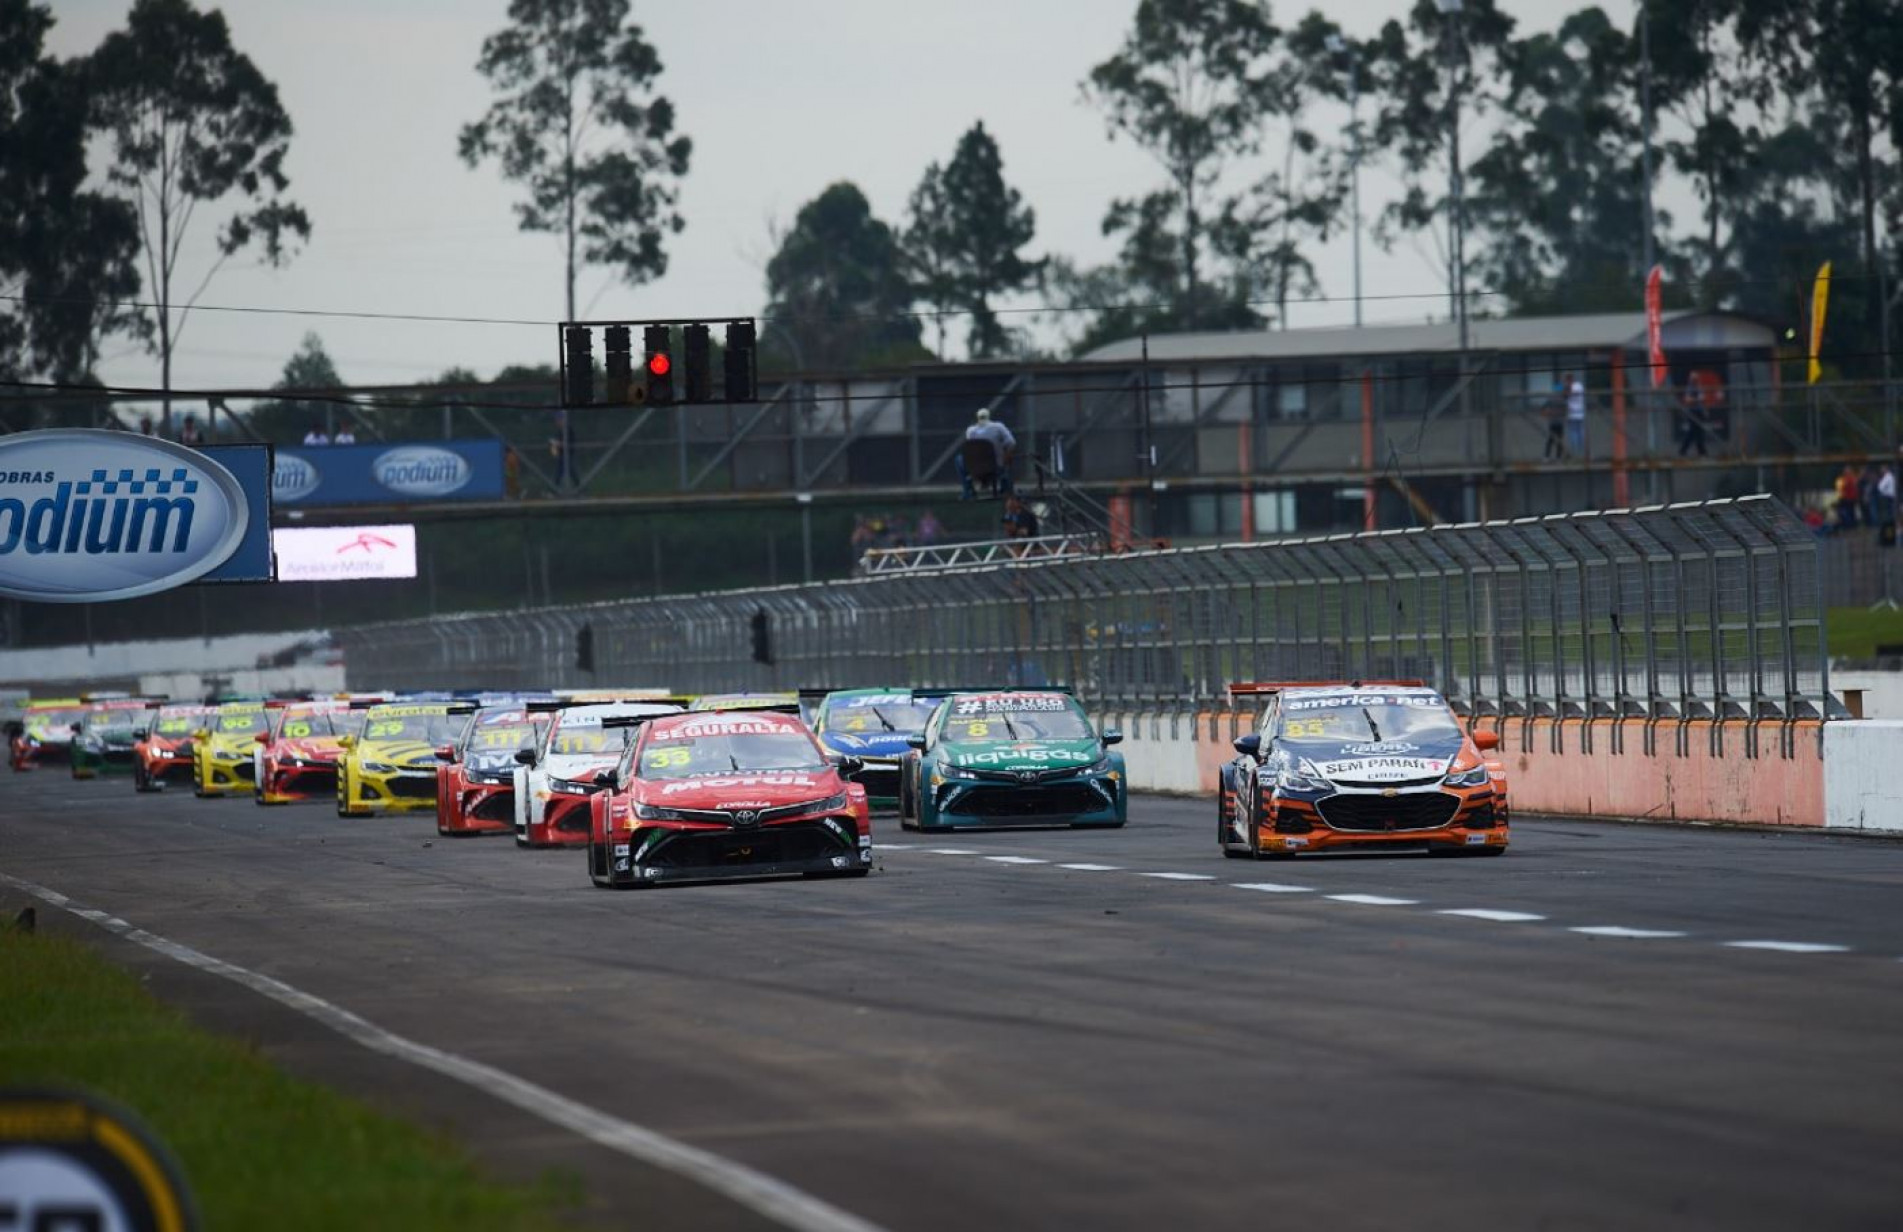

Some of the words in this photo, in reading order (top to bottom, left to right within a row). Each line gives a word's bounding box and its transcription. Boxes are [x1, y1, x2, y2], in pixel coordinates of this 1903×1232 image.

[384, 460, 457, 484] podium
[1289, 694, 1385, 710] america
[284, 720, 311, 738] 10
[655, 722, 797, 740] SEGURALTA
[968, 722, 988, 737] 8
[650, 747, 691, 768] 33
[959, 750, 1091, 767] liquigas
[1326, 761, 1365, 774] SEM
[661, 777, 817, 795] MOTUL
[715, 801, 772, 810] COROLLA
